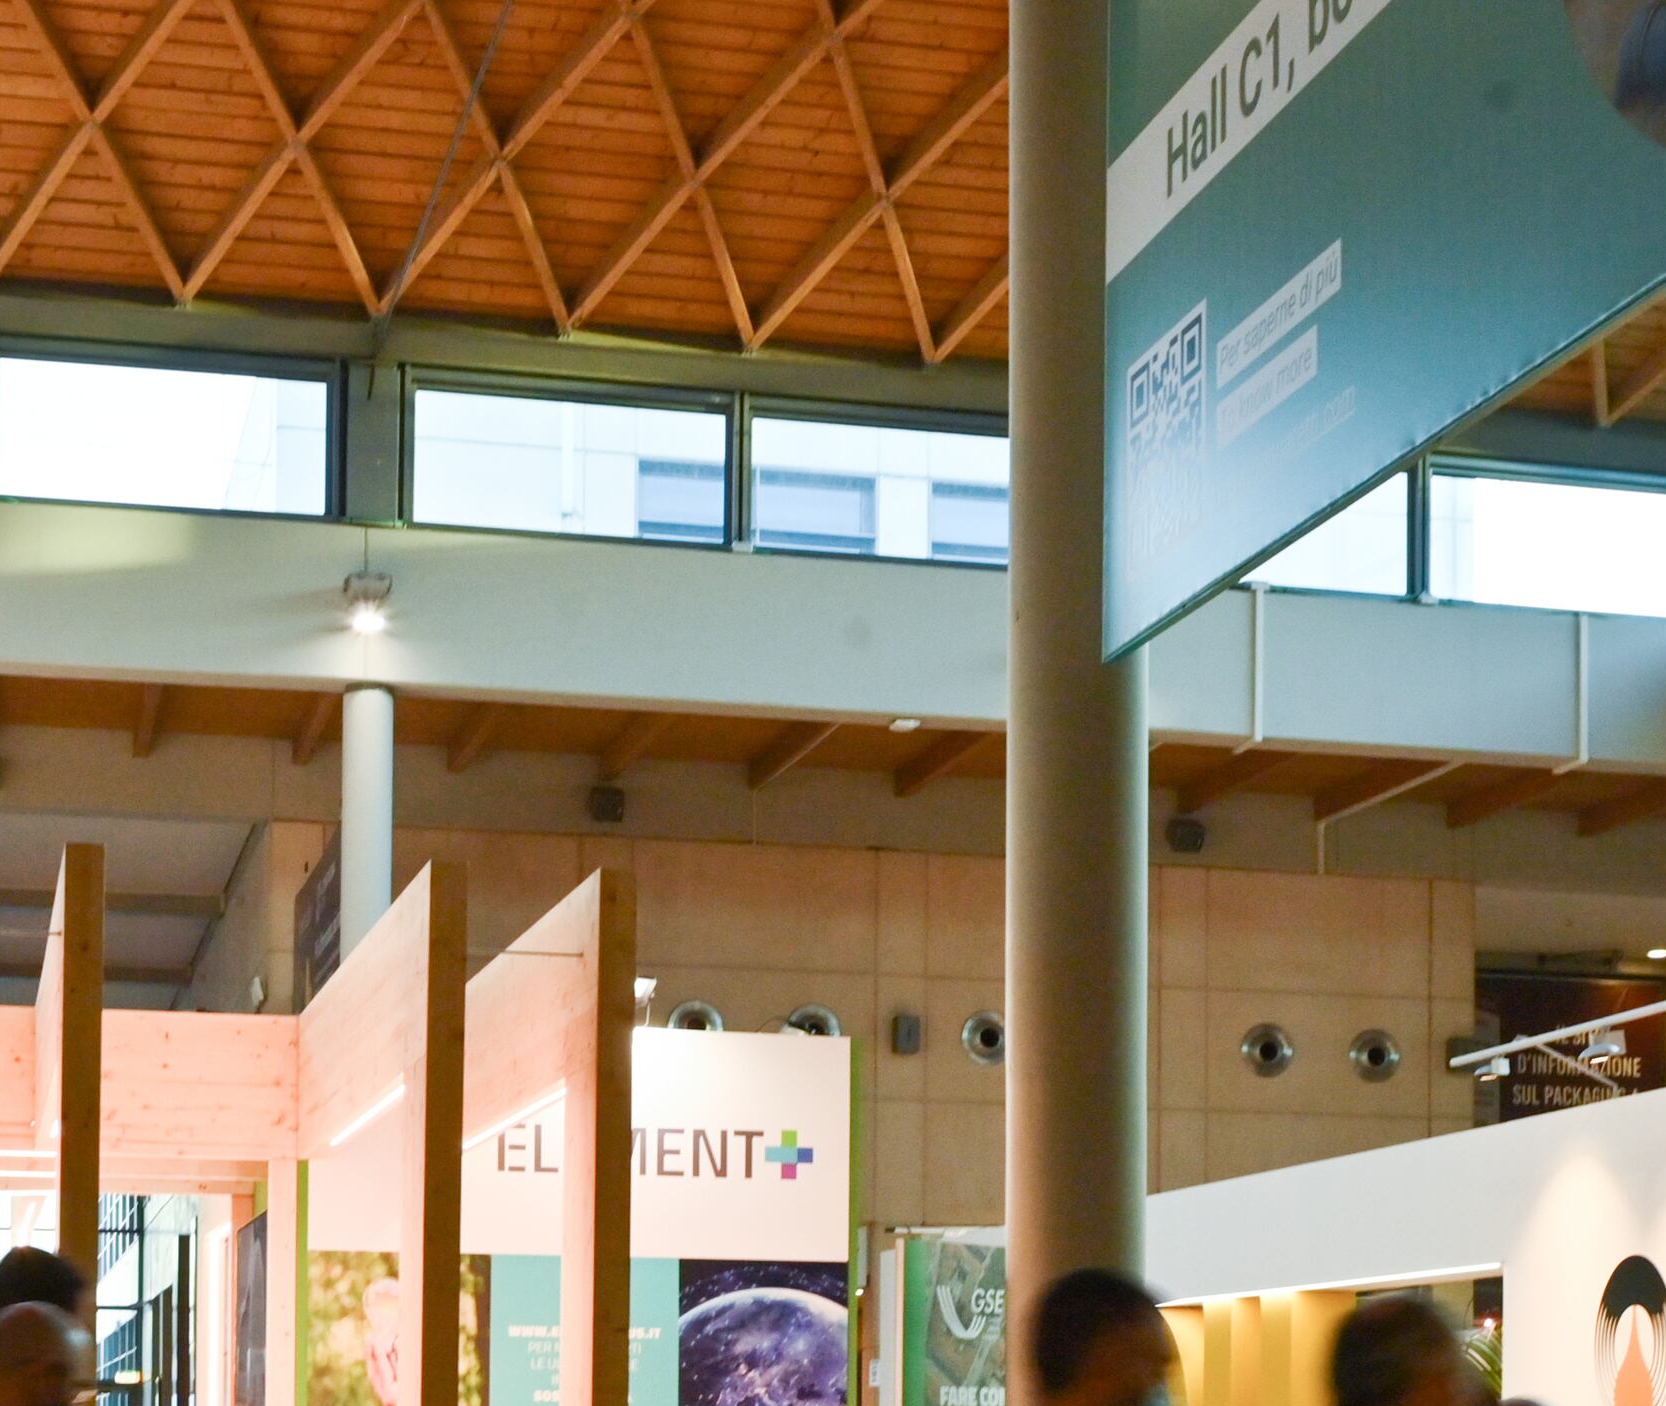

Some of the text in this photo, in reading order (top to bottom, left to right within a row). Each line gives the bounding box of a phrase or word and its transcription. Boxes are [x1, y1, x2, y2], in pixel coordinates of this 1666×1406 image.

[1167, 64, 1227, 199] Hall
[1239, 13, 1295, 117] C1,
[1244, 292, 1296, 354] saperne
[1299, 270, 1313, 308] di
[1276, 346, 1312, 393] more
[1512, 1084, 1540, 1105] SUL
[971, 1288, 1005, 1314] GSE
